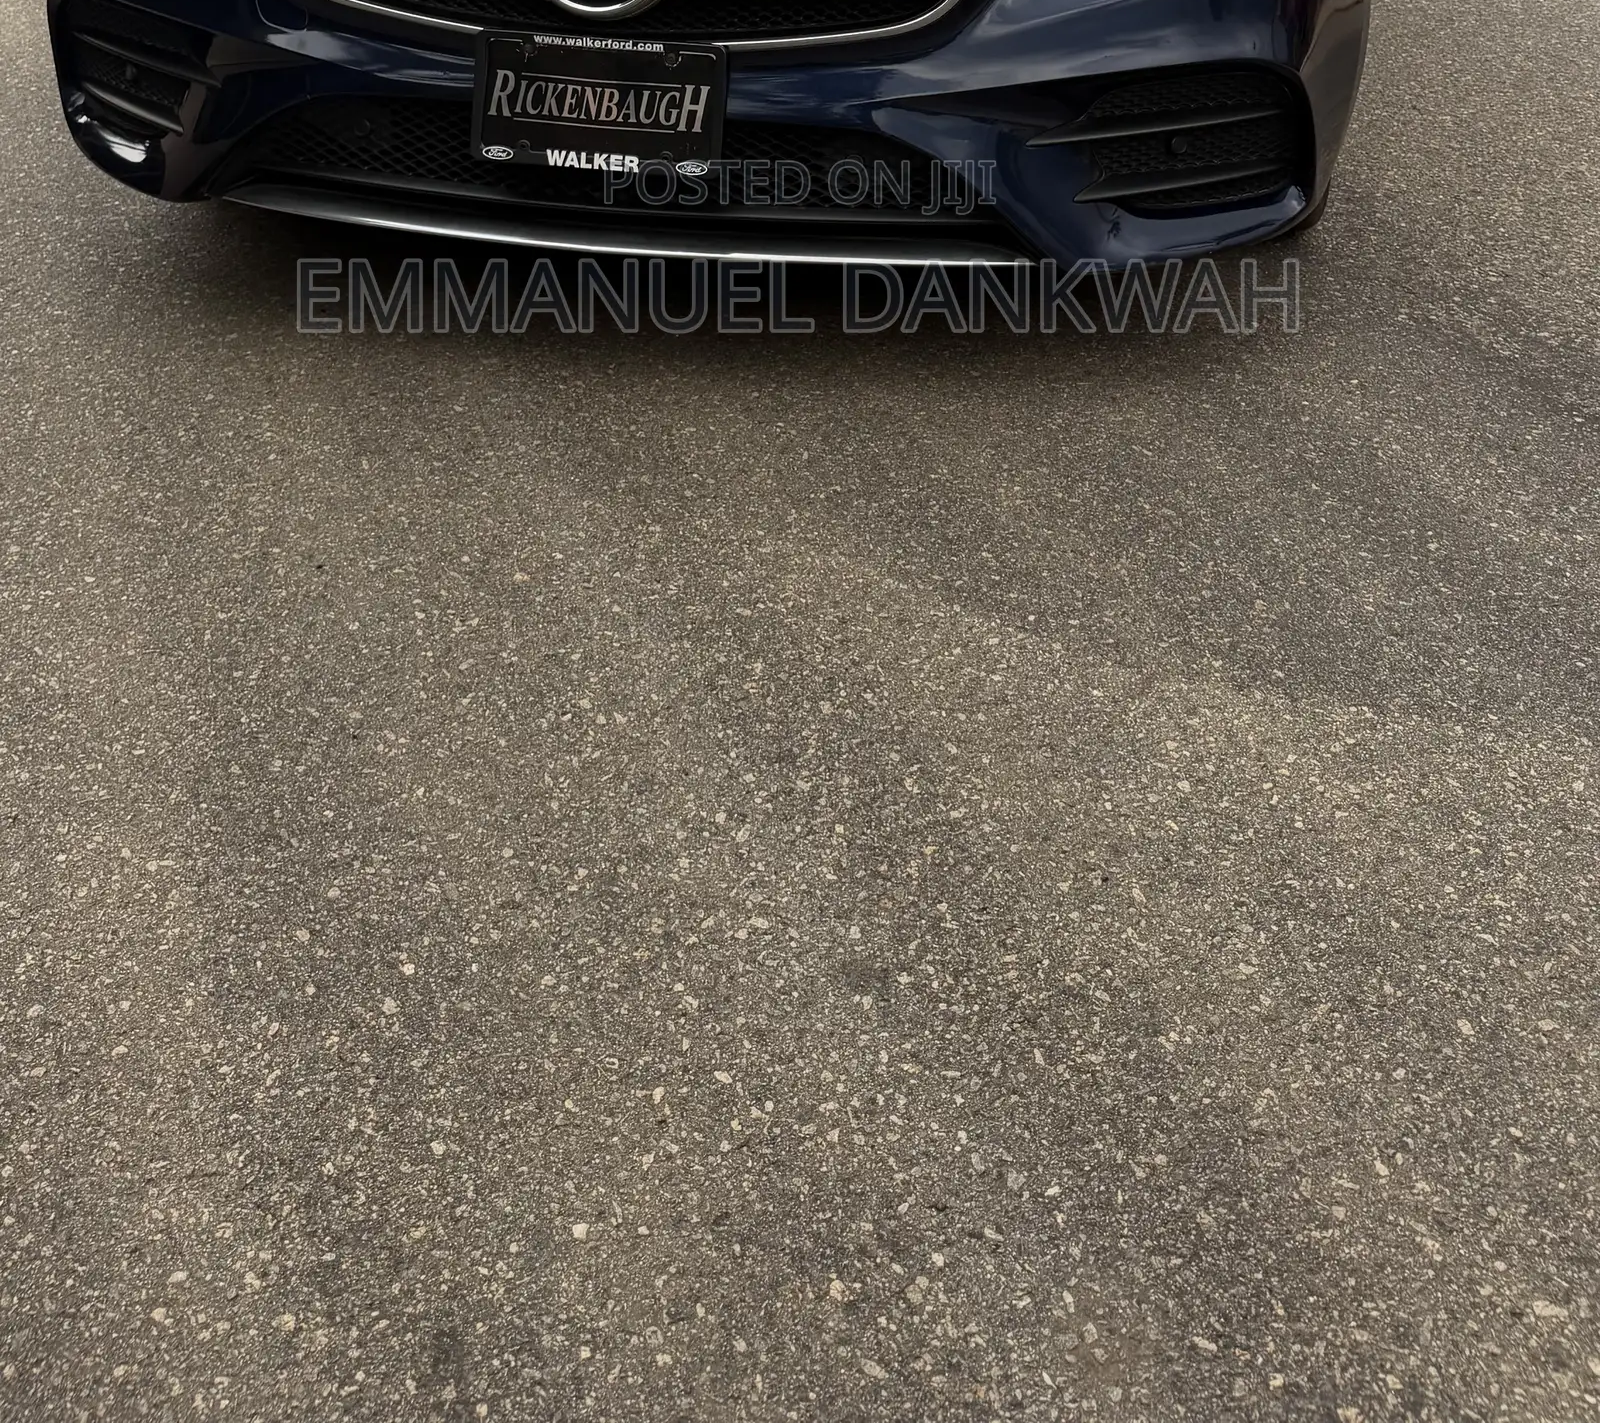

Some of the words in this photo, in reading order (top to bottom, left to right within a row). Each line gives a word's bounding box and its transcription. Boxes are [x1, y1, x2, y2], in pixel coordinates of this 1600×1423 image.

[533, 34, 664, 52] www.walkerford.com
[485, 148, 510, 159] Ford
[546, 149, 640, 173] WALKER
[679, 163, 704, 174] Ford
